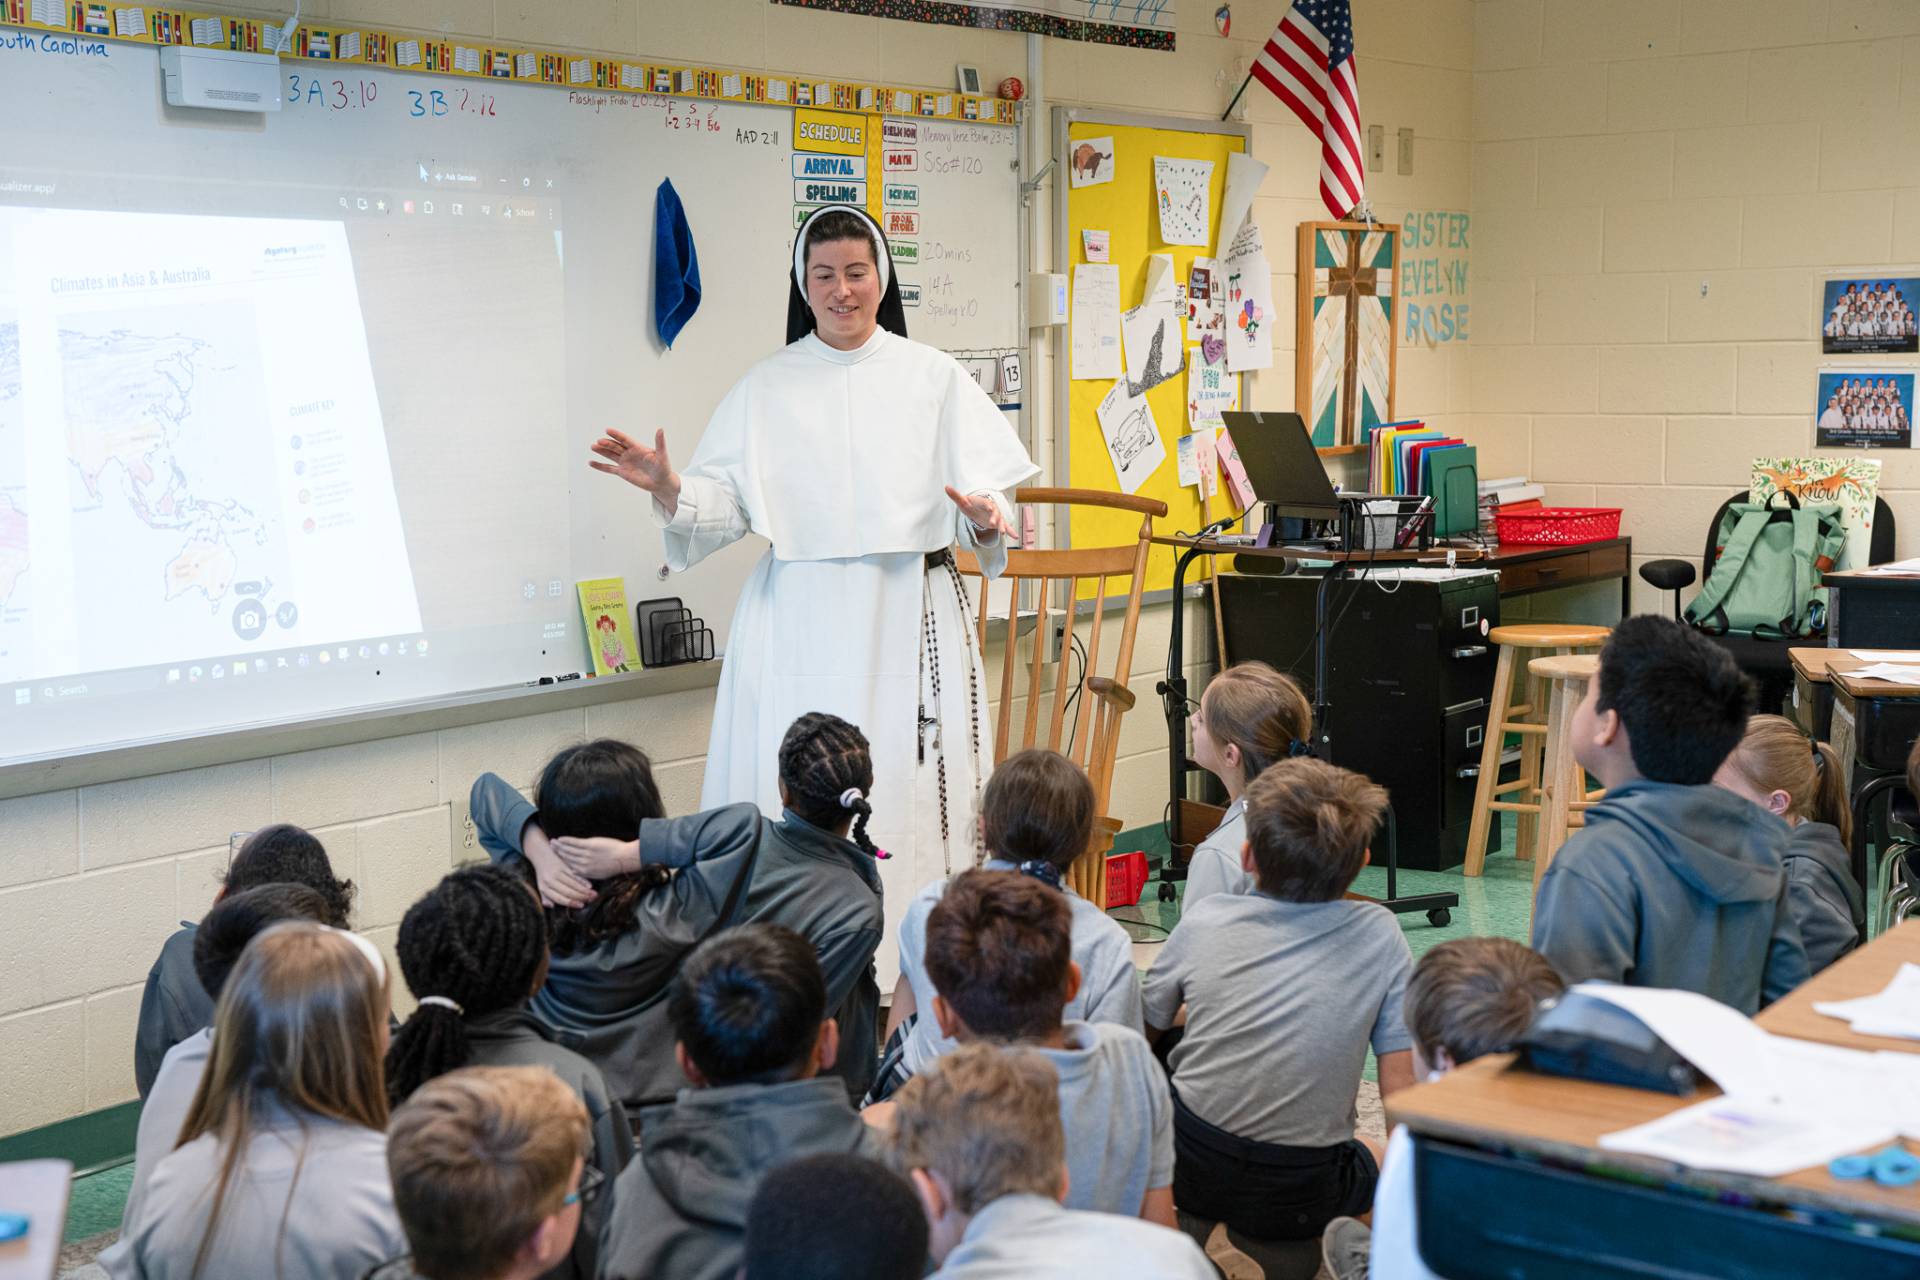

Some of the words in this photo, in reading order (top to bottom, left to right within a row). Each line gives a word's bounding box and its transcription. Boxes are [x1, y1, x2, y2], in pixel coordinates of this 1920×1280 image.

[41, 34, 109, 57] Carolina
[735, 127, 759, 145] AAD
[800, 120, 862, 145] SCHEDULE
[804, 157, 854, 176] ARRIVAL
[805, 184, 857, 203] SPELLING
[515, 208, 536, 217] School
[1402, 211, 1470, 249] SISTER
[890, 245, 918, 258] EADING
[50, 276, 104, 294] Climates
[106, 273, 119, 289] in
[122, 271, 146, 289] Asia
[149, 269, 159, 286] &
[162, 265, 212, 284] Australia
[1400, 257, 1469, 297] EVELYN
[1405, 302, 1470, 348] ROSE
[970, 367, 982, 385] ril
[1005, 365, 1020, 382] 13
[1794, 482, 1843, 503] Know
[59, 682, 89, 697] Search
